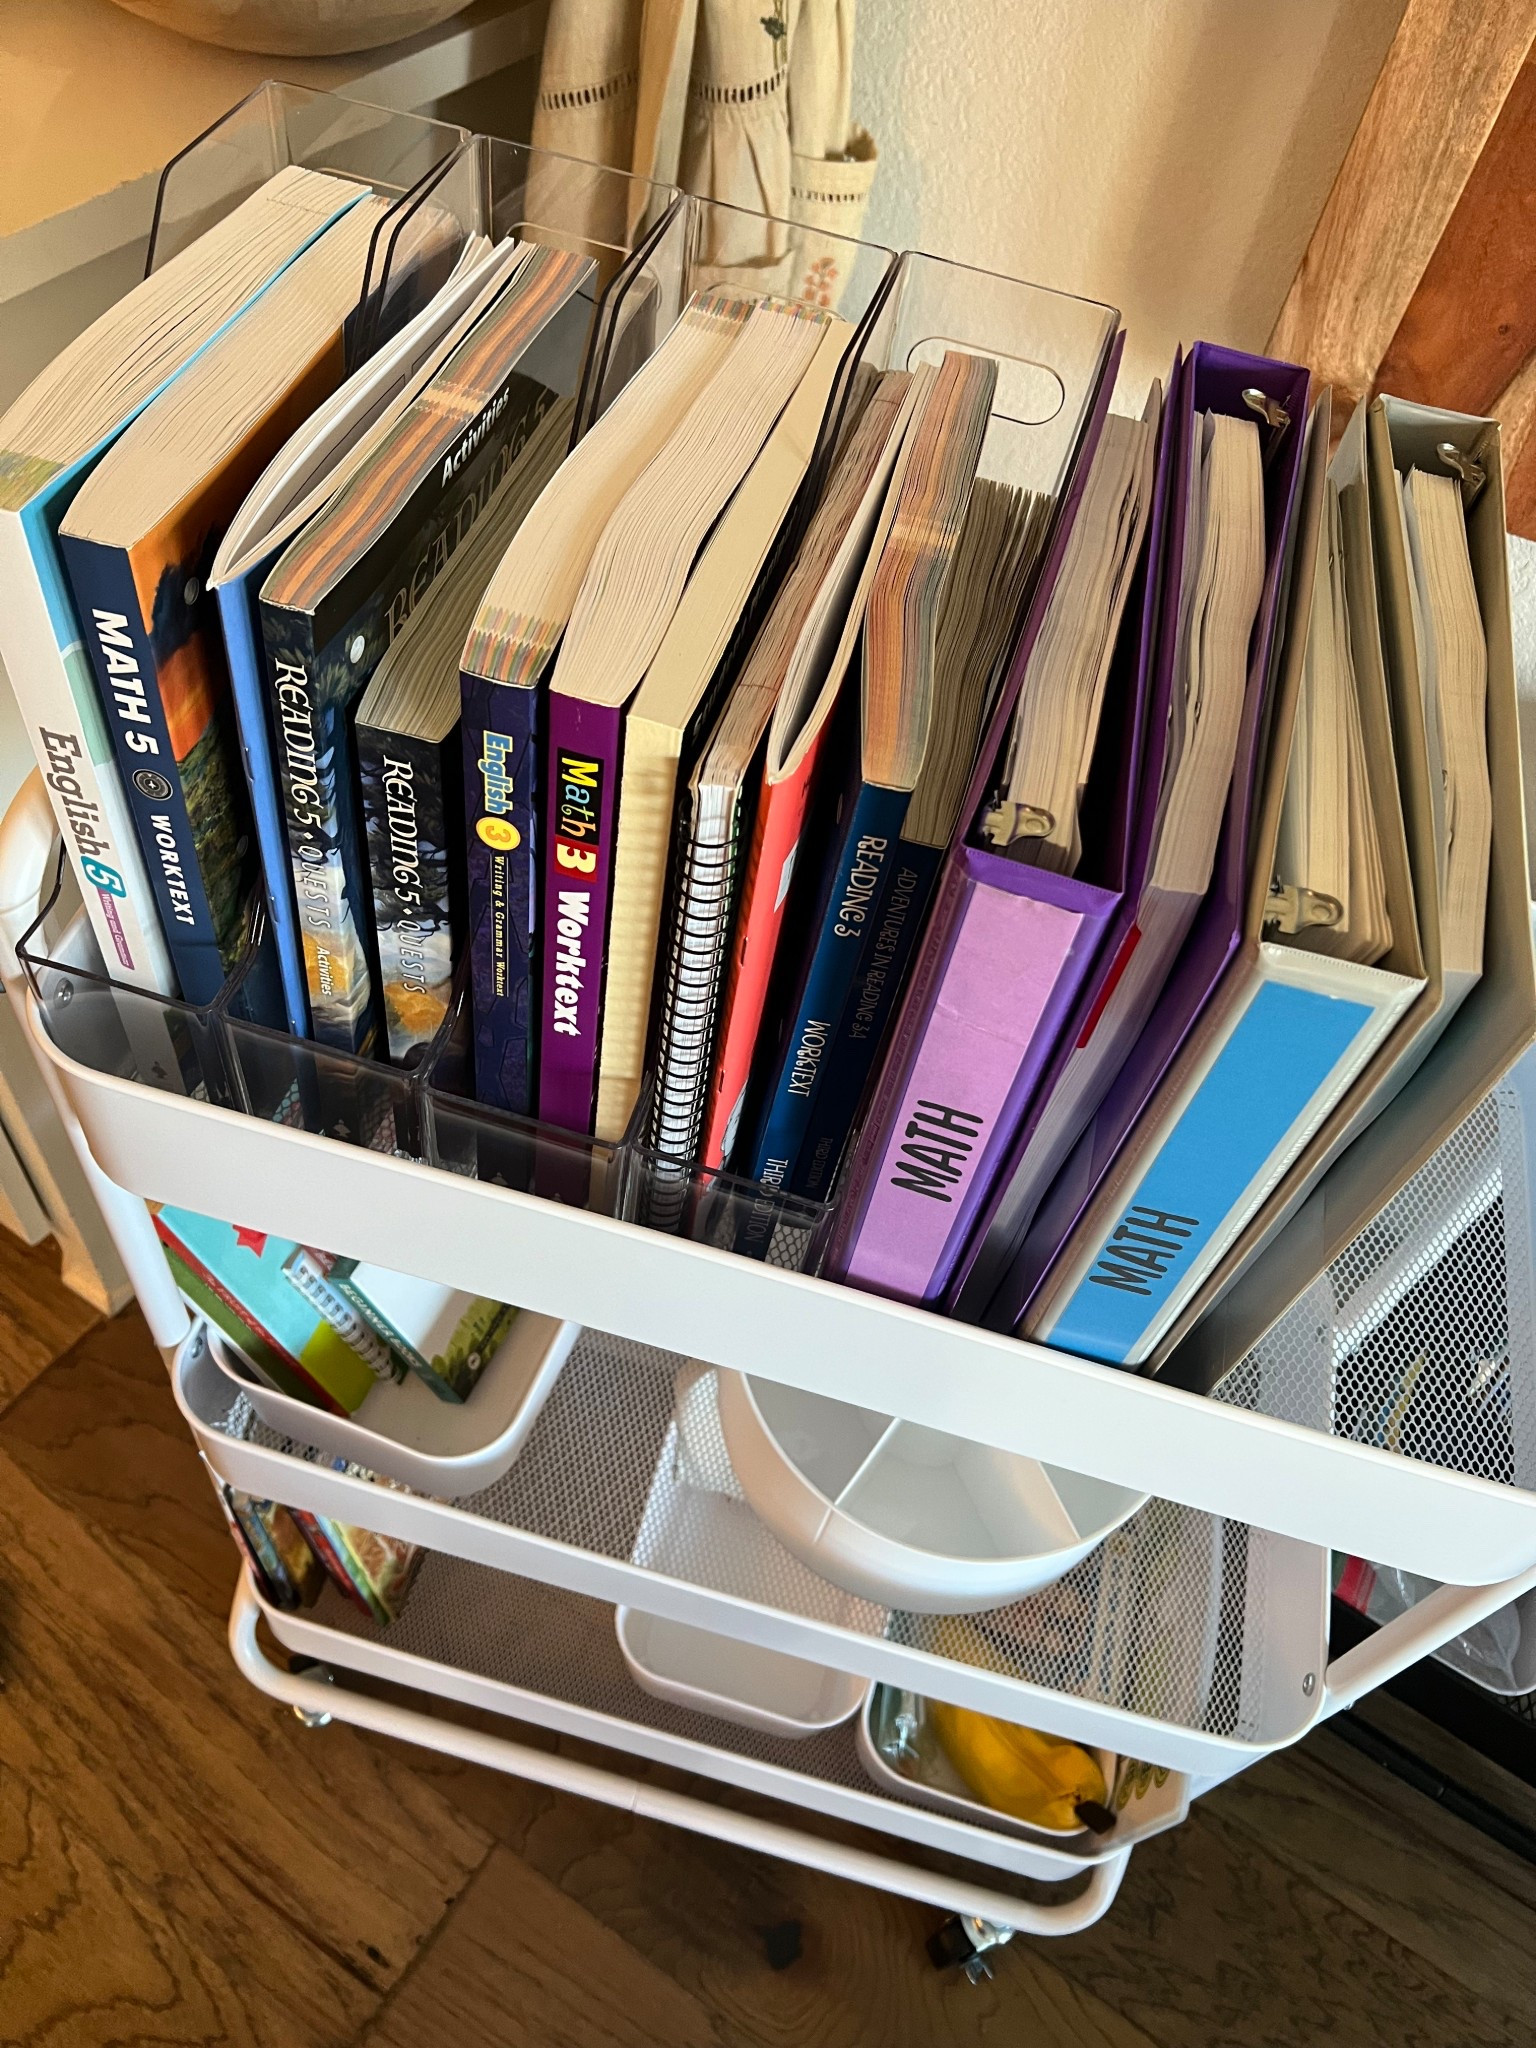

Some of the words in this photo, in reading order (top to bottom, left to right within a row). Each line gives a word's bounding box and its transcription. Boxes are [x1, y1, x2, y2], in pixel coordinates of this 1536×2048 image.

[441, 387, 511, 489] Activities
[275, 658, 320, 806] READING
[92, 609, 152, 726] MATH
[124, 729, 160, 756] 5
[150, 814, 194, 926] WORKTEXT
[479, 730, 513, 813] English
[560, 756, 600, 837] Math
[39, 726, 111, 856] English
[85, 863, 122, 892] 5
[293, 801, 325, 830] 5
[383, 755, 420, 887] READING
[485, 823, 513, 843] 3
[297, 844, 332, 930] QUESTS
[492, 855, 503, 896] Writing
[556, 842, 597, 874] 3
[839, 834, 888, 922] READING
[101, 892, 114, 918] Writing
[109, 920, 121, 933] and
[394, 884, 421, 906] 5
[834, 917, 861, 939] 3
[874, 866, 918, 952] ADVENTURES
[397, 919, 427, 994] QUESTS
[495, 912, 504, 957] Grammar
[553, 891, 590, 1036] Worktext
[870, 952, 892, 970] IN
[315, 945, 335, 997] Activities
[495, 961, 505, 996] Worktext
[854, 969, 886, 1022] READING
[787, 1020, 831, 1097] WORKTEXT
[848, 1022, 869, 1040] 3A
[891, 1100, 984, 1203] MATH
[743, 1192, 777, 1245] EDITION
[1089, 1206, 1200, 1296] MATH
[339, 1282, 395, 1339] BEGINNER
